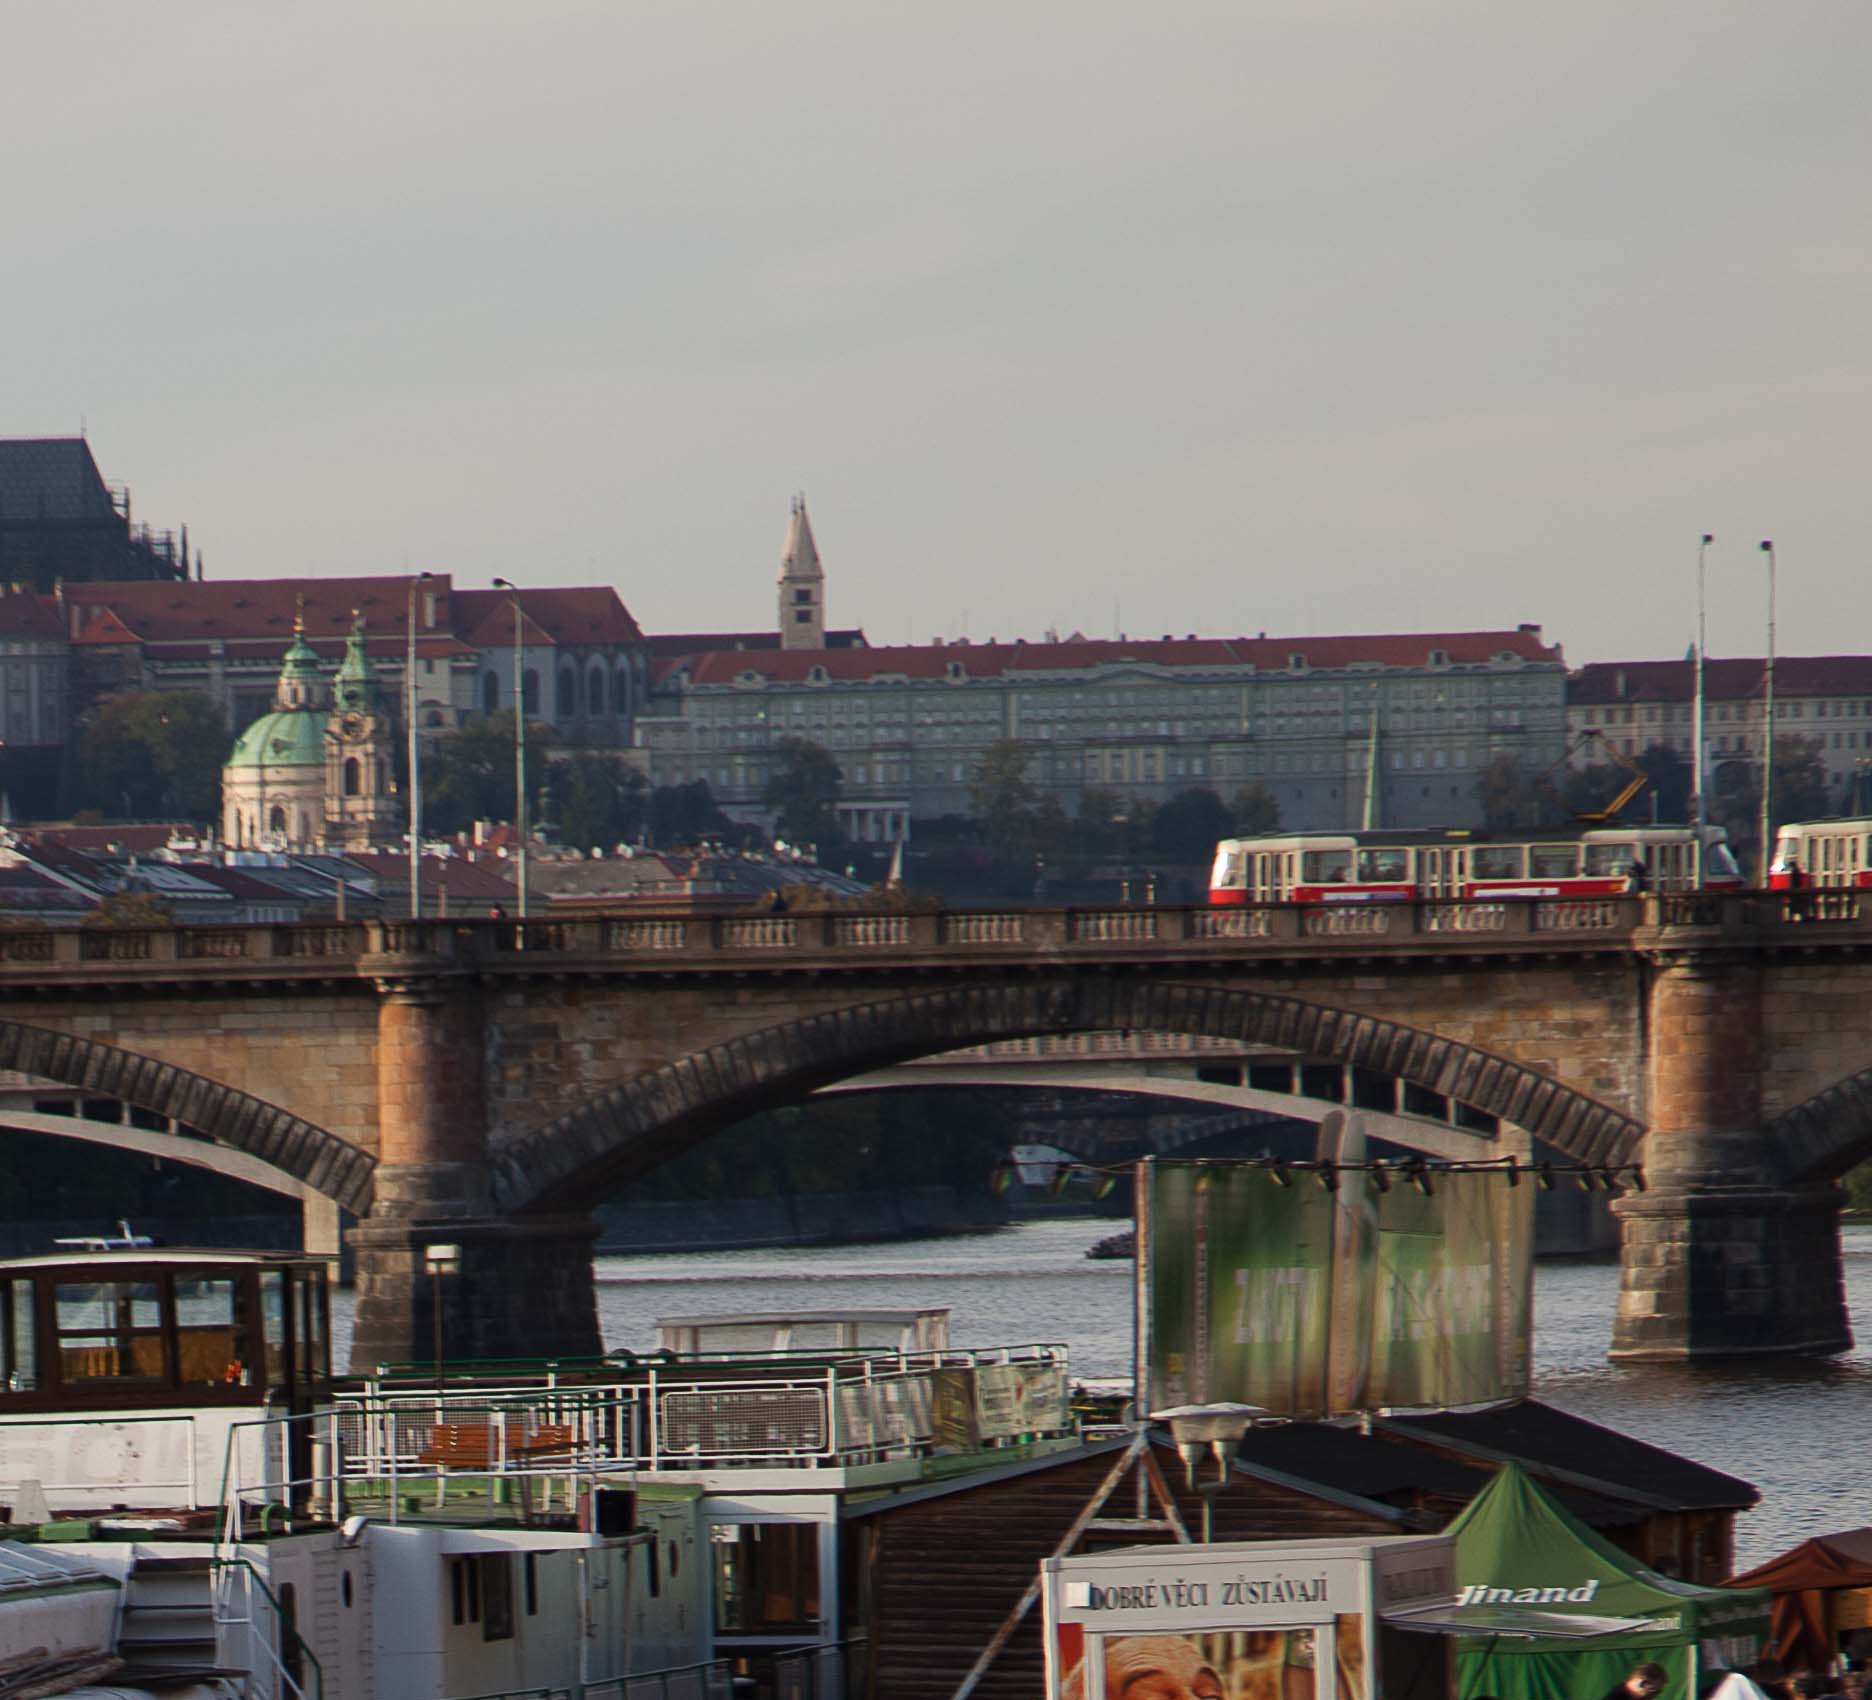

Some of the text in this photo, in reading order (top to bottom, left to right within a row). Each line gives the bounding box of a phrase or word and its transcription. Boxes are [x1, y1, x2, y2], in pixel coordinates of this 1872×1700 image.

[1090, 1572, 1327, 1609] DOBRÉ VĚCI ZŮSTÁVAJÍ
